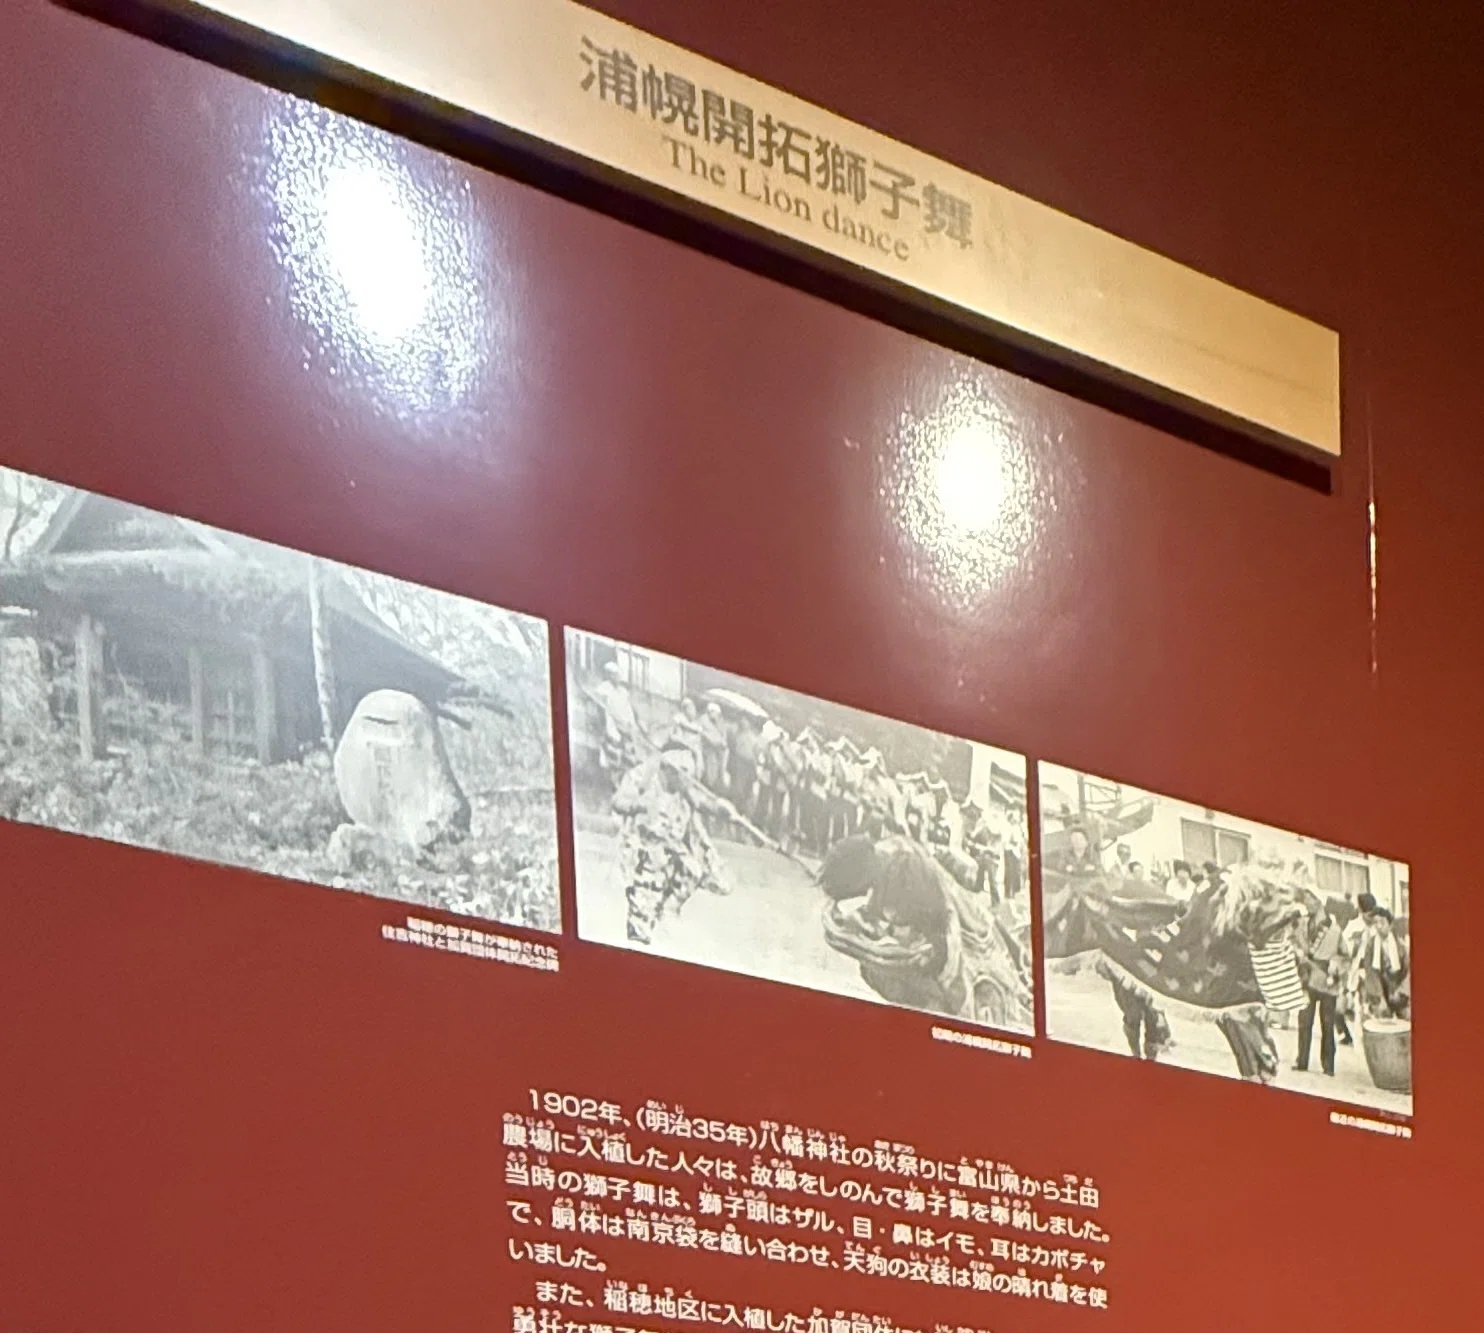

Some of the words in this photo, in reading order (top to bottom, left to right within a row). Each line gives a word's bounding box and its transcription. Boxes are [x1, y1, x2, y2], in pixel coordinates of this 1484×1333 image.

[579, 34, 974, 250] 浦幌開拓獅子舞
[662, 135, 727, 188] The
[739, 167, 813, 222] Lion
[822, 204, 911, 262] dance
[508, 1237, 607, 1272] いました。
